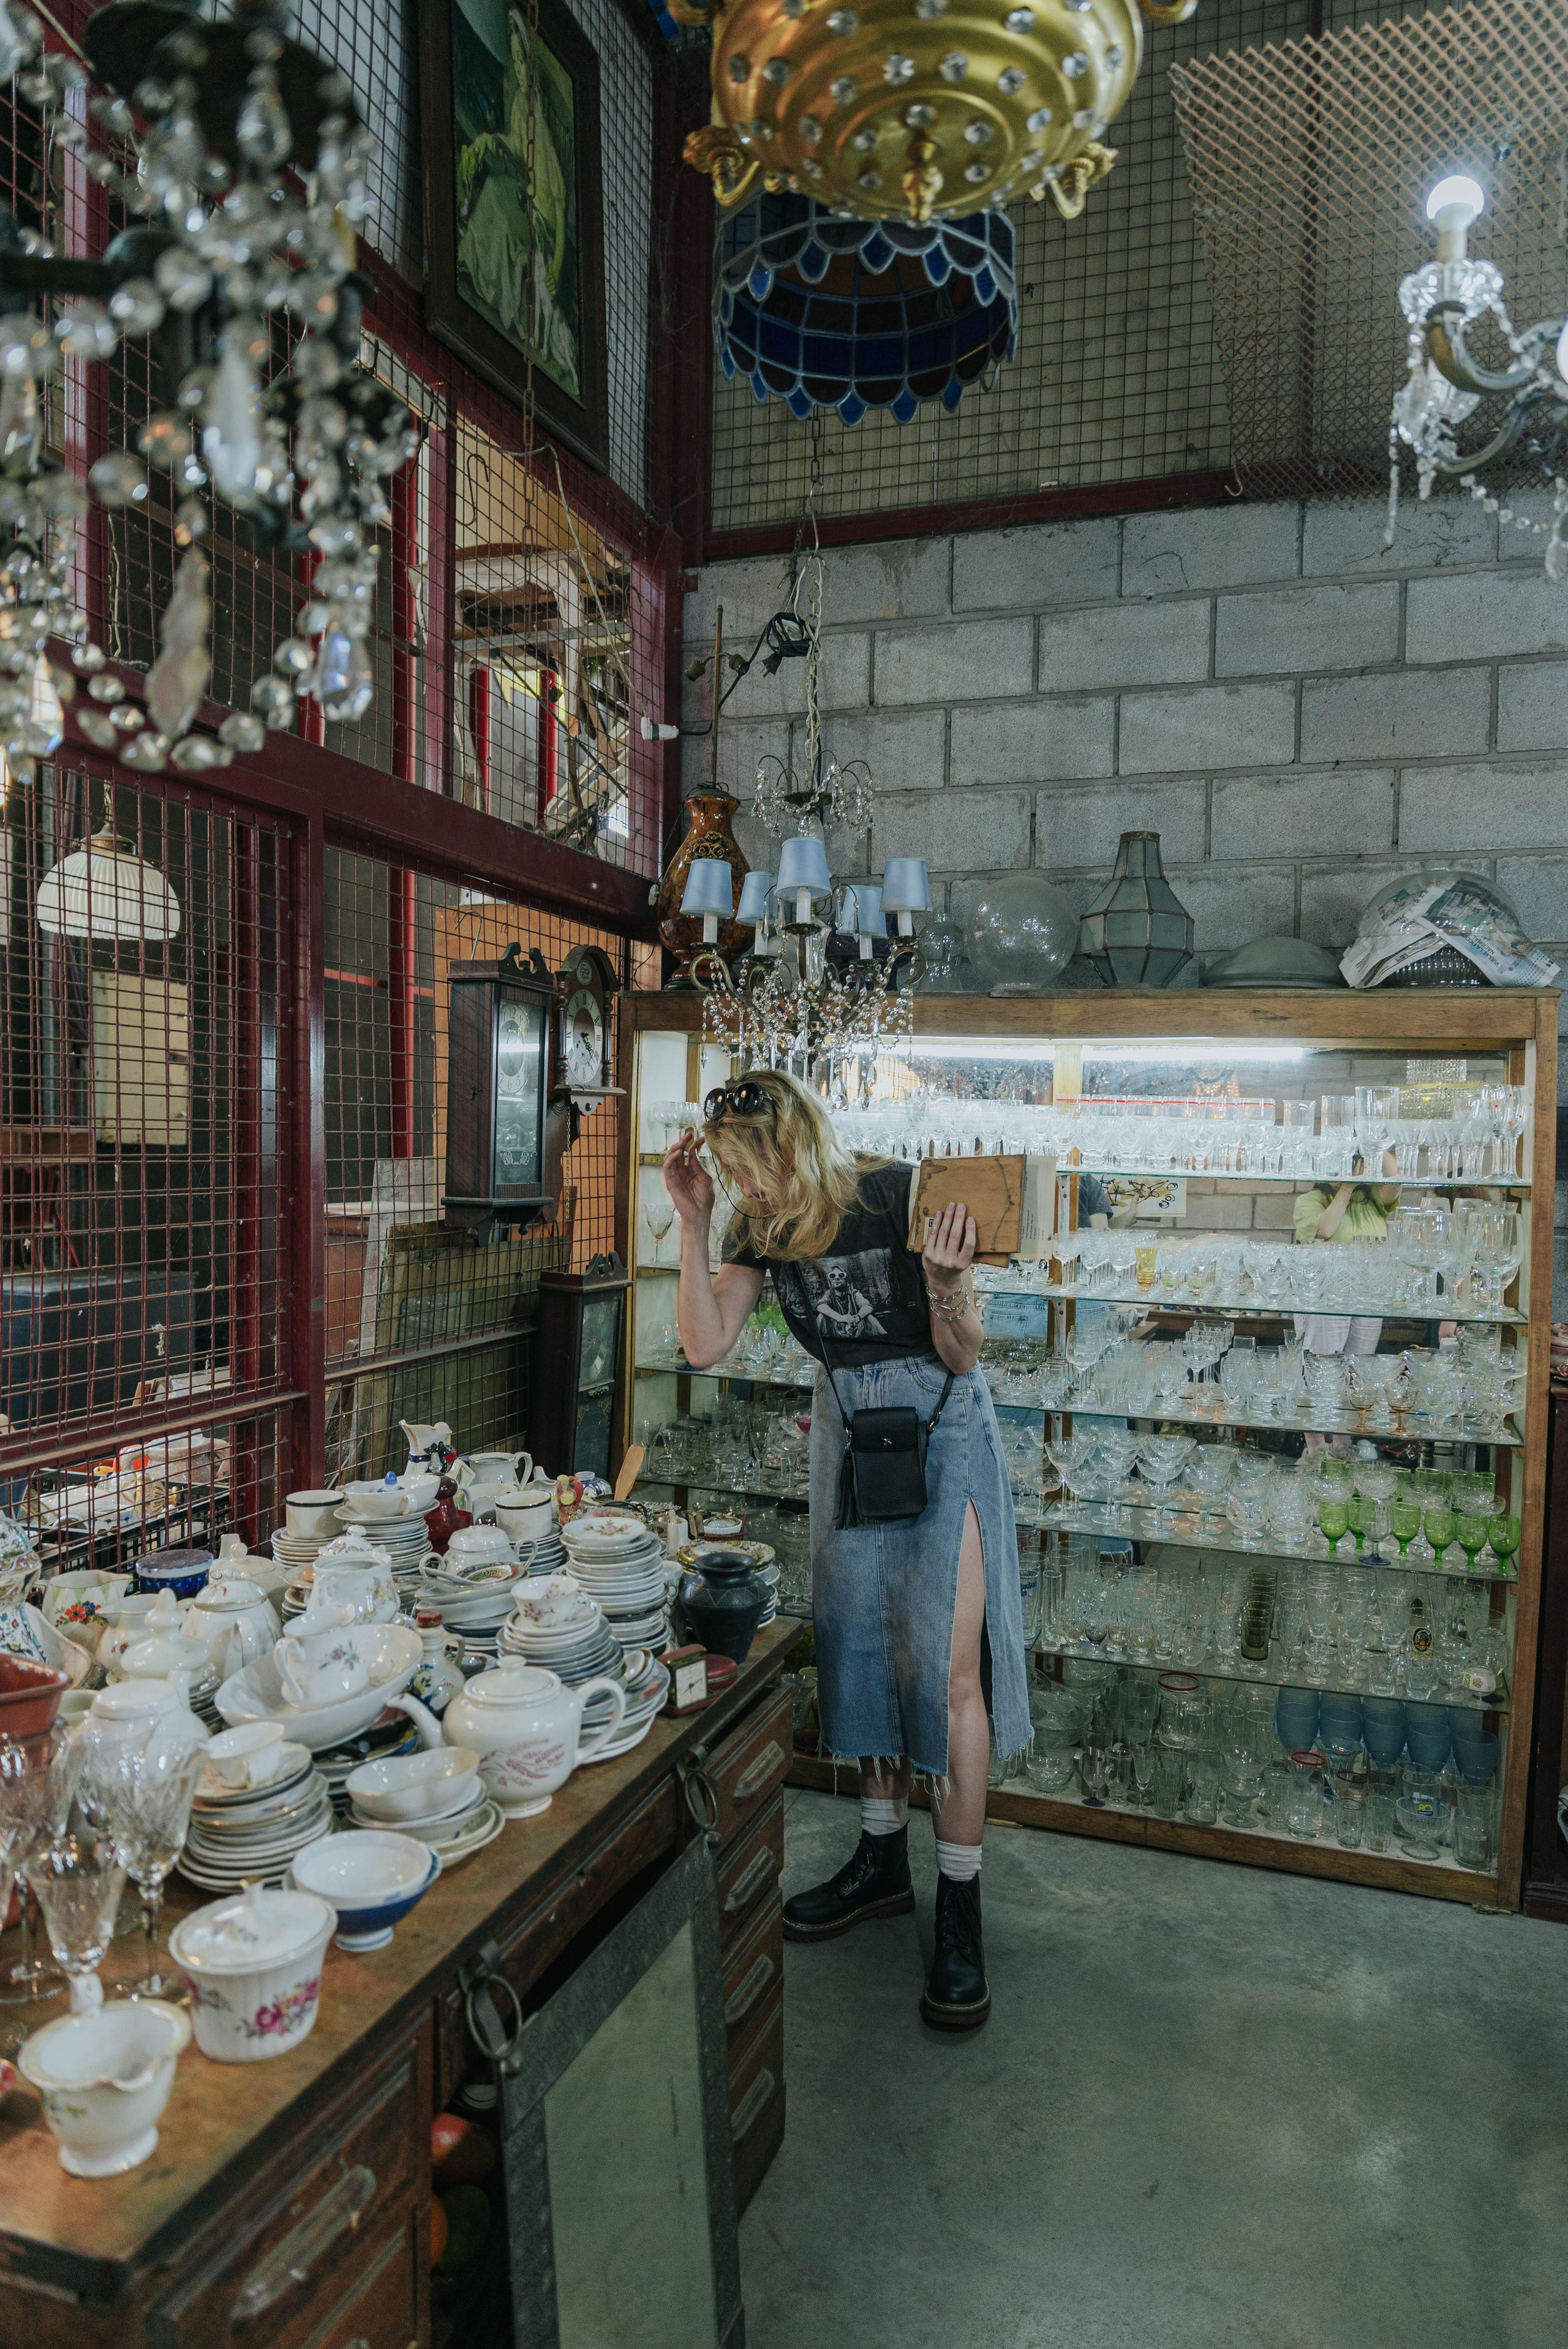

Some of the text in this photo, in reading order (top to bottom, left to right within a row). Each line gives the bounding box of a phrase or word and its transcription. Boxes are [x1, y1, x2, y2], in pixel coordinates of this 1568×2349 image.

[1462, 933, 1477, 947] FICCI
[1473, 935, 1495, 954] NACIONAL
[1482, 951, 1499, 967] VUELVE
[509, 1007, 516, 1019] 12
[507, 1077, 512, 1091] 6
[516, 1075, 521, 1087] 5
